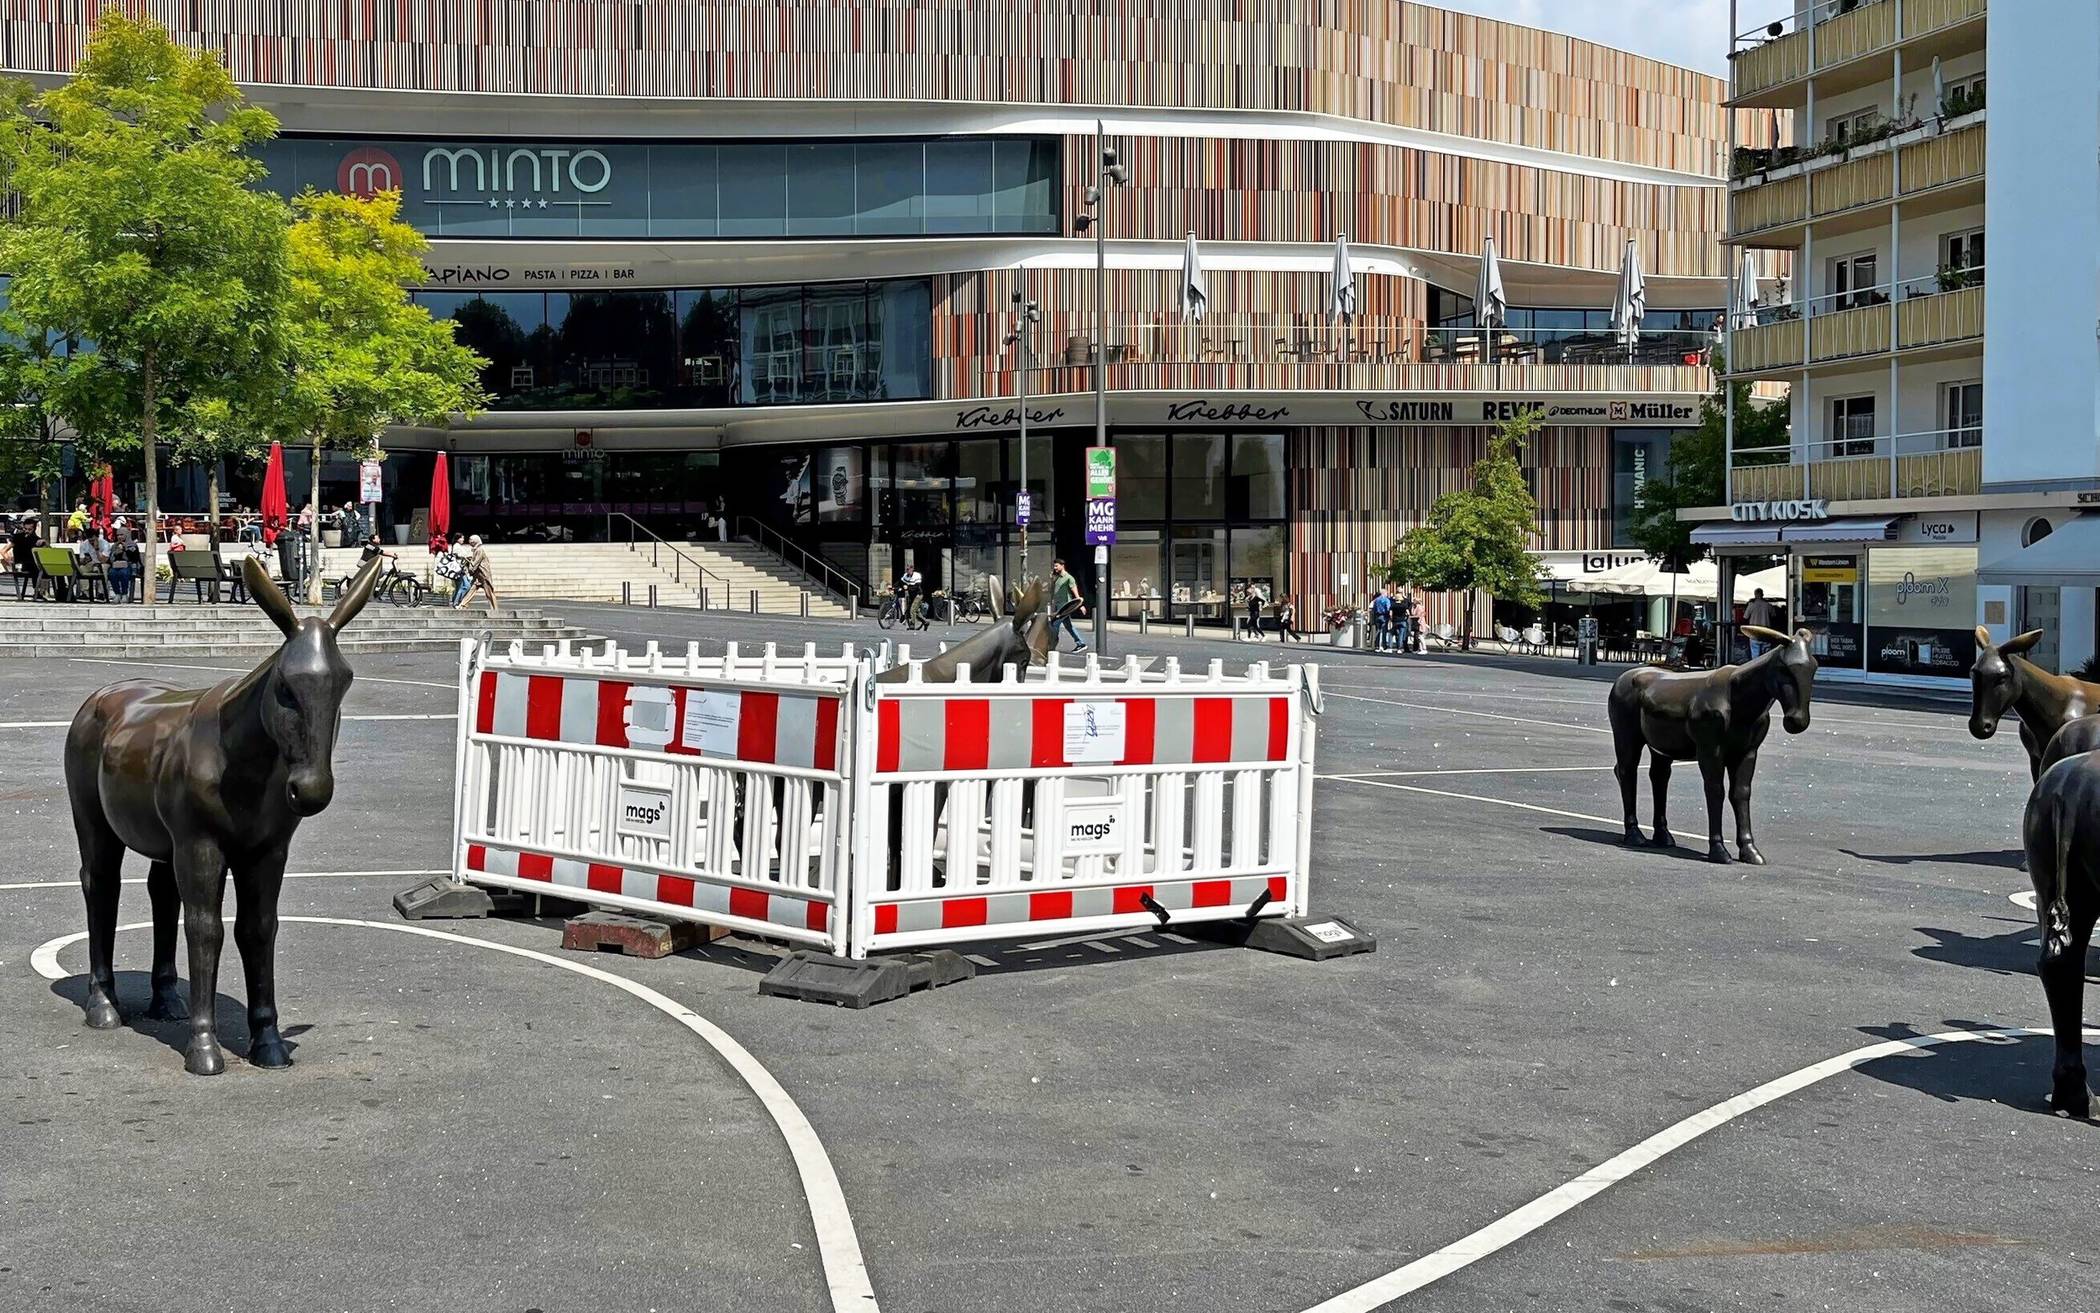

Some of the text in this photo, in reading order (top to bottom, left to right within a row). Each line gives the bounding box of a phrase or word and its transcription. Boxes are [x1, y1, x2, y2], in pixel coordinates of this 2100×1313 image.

[524, 270, 557, 280] PASTA
[570, 270, 600, 279] PIZZA
[613, 269, 635, 279] BAR
[1167, 400, 1289, 421] Krebber
[1390, 401, 1453, 421] SATURN
[1483, 401, 1546, 421] REWE
[1560, 407, 1607, 416] DECATHLON
[1630, 403, 1693, 419] Müller
[1089, 502, 1114, 516] MG
[1731, 500, 1827, 521] CITY KIOSK
[1089, 516, 1114, 524] KANN
[1089, 524, 1114, 532] MEHR
[1921, 522, 1947, 536] Lyca
[1881, 643, 1906, 660] ploom
[626, 803, 661, 825] mags
[1071, 822, 1111, 840] mags
